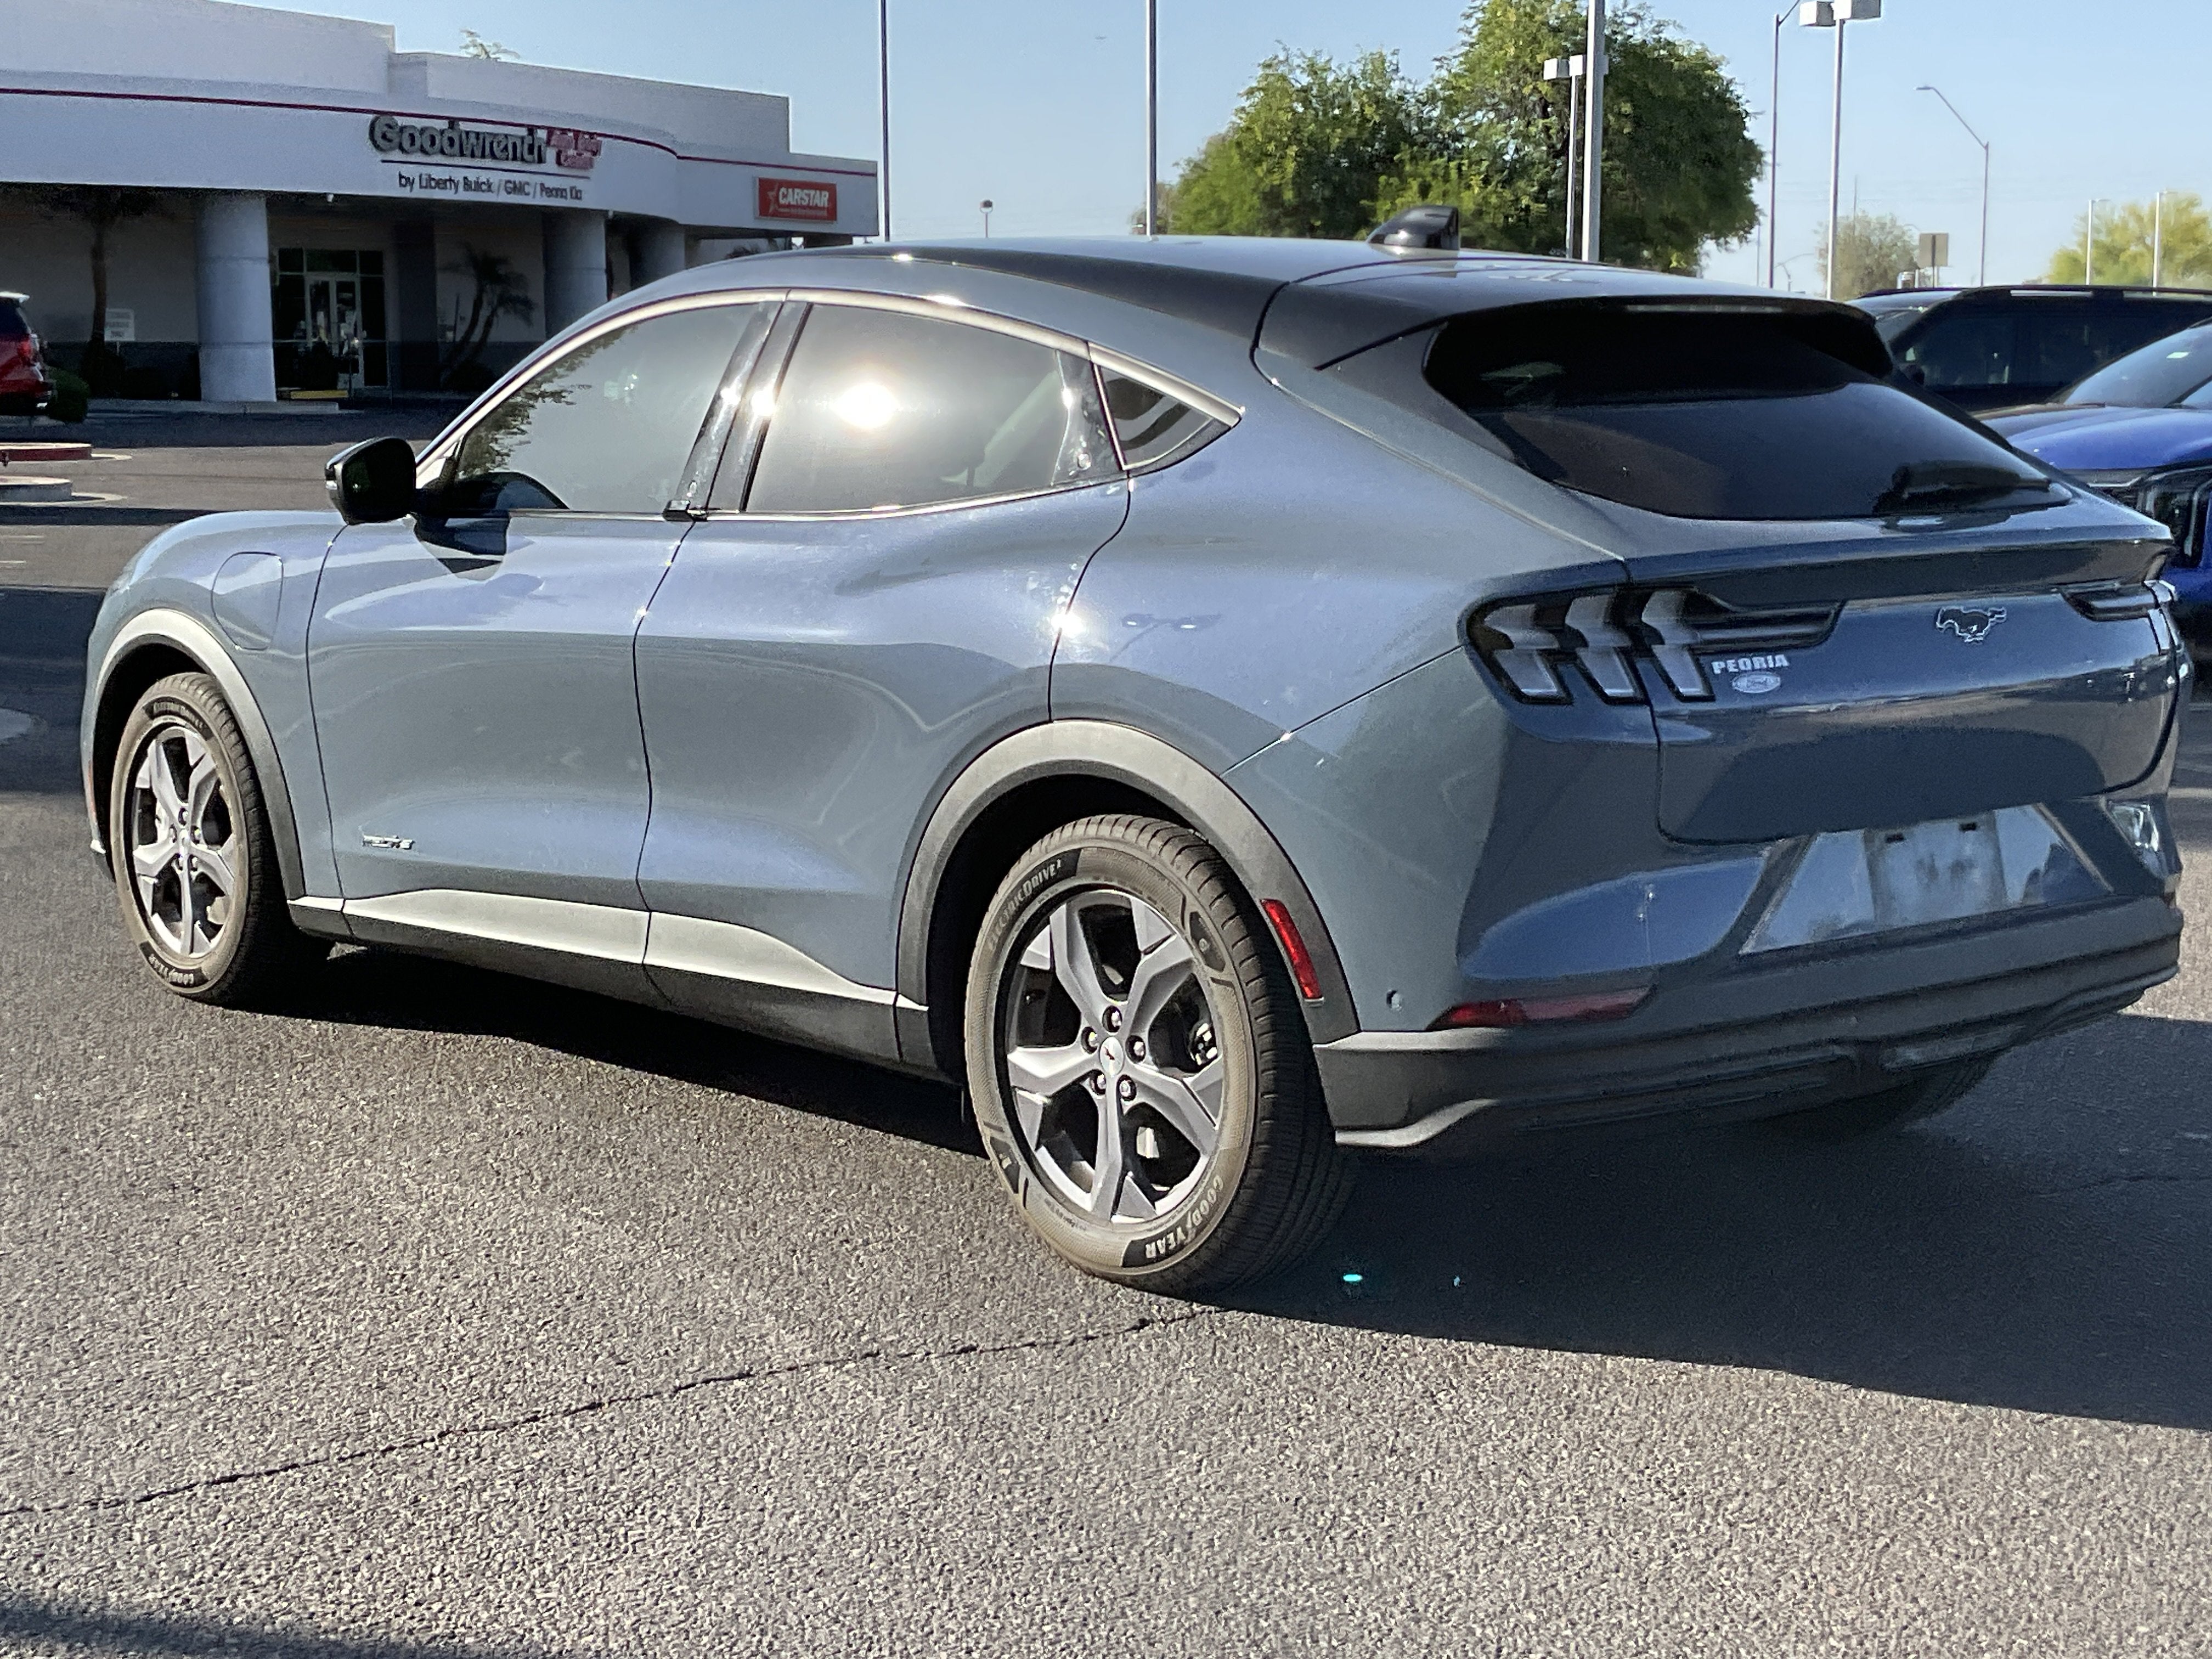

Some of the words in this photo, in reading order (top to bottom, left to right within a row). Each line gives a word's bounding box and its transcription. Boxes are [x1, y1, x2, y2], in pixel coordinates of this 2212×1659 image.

[369, 115, 547, 163] Goodwrench
[399, 171, 415, 192] by
[419, 173, 460, 194] Liberty
[463, 176, 494, 193] Buick
[504, 179, 530, 195] GMC
[778, 187, 829, 207] CARSTAR
[1711, 654, 1790, 674] PEORIA
[1144, 1175, 1223, 1259] GOODYEAR
